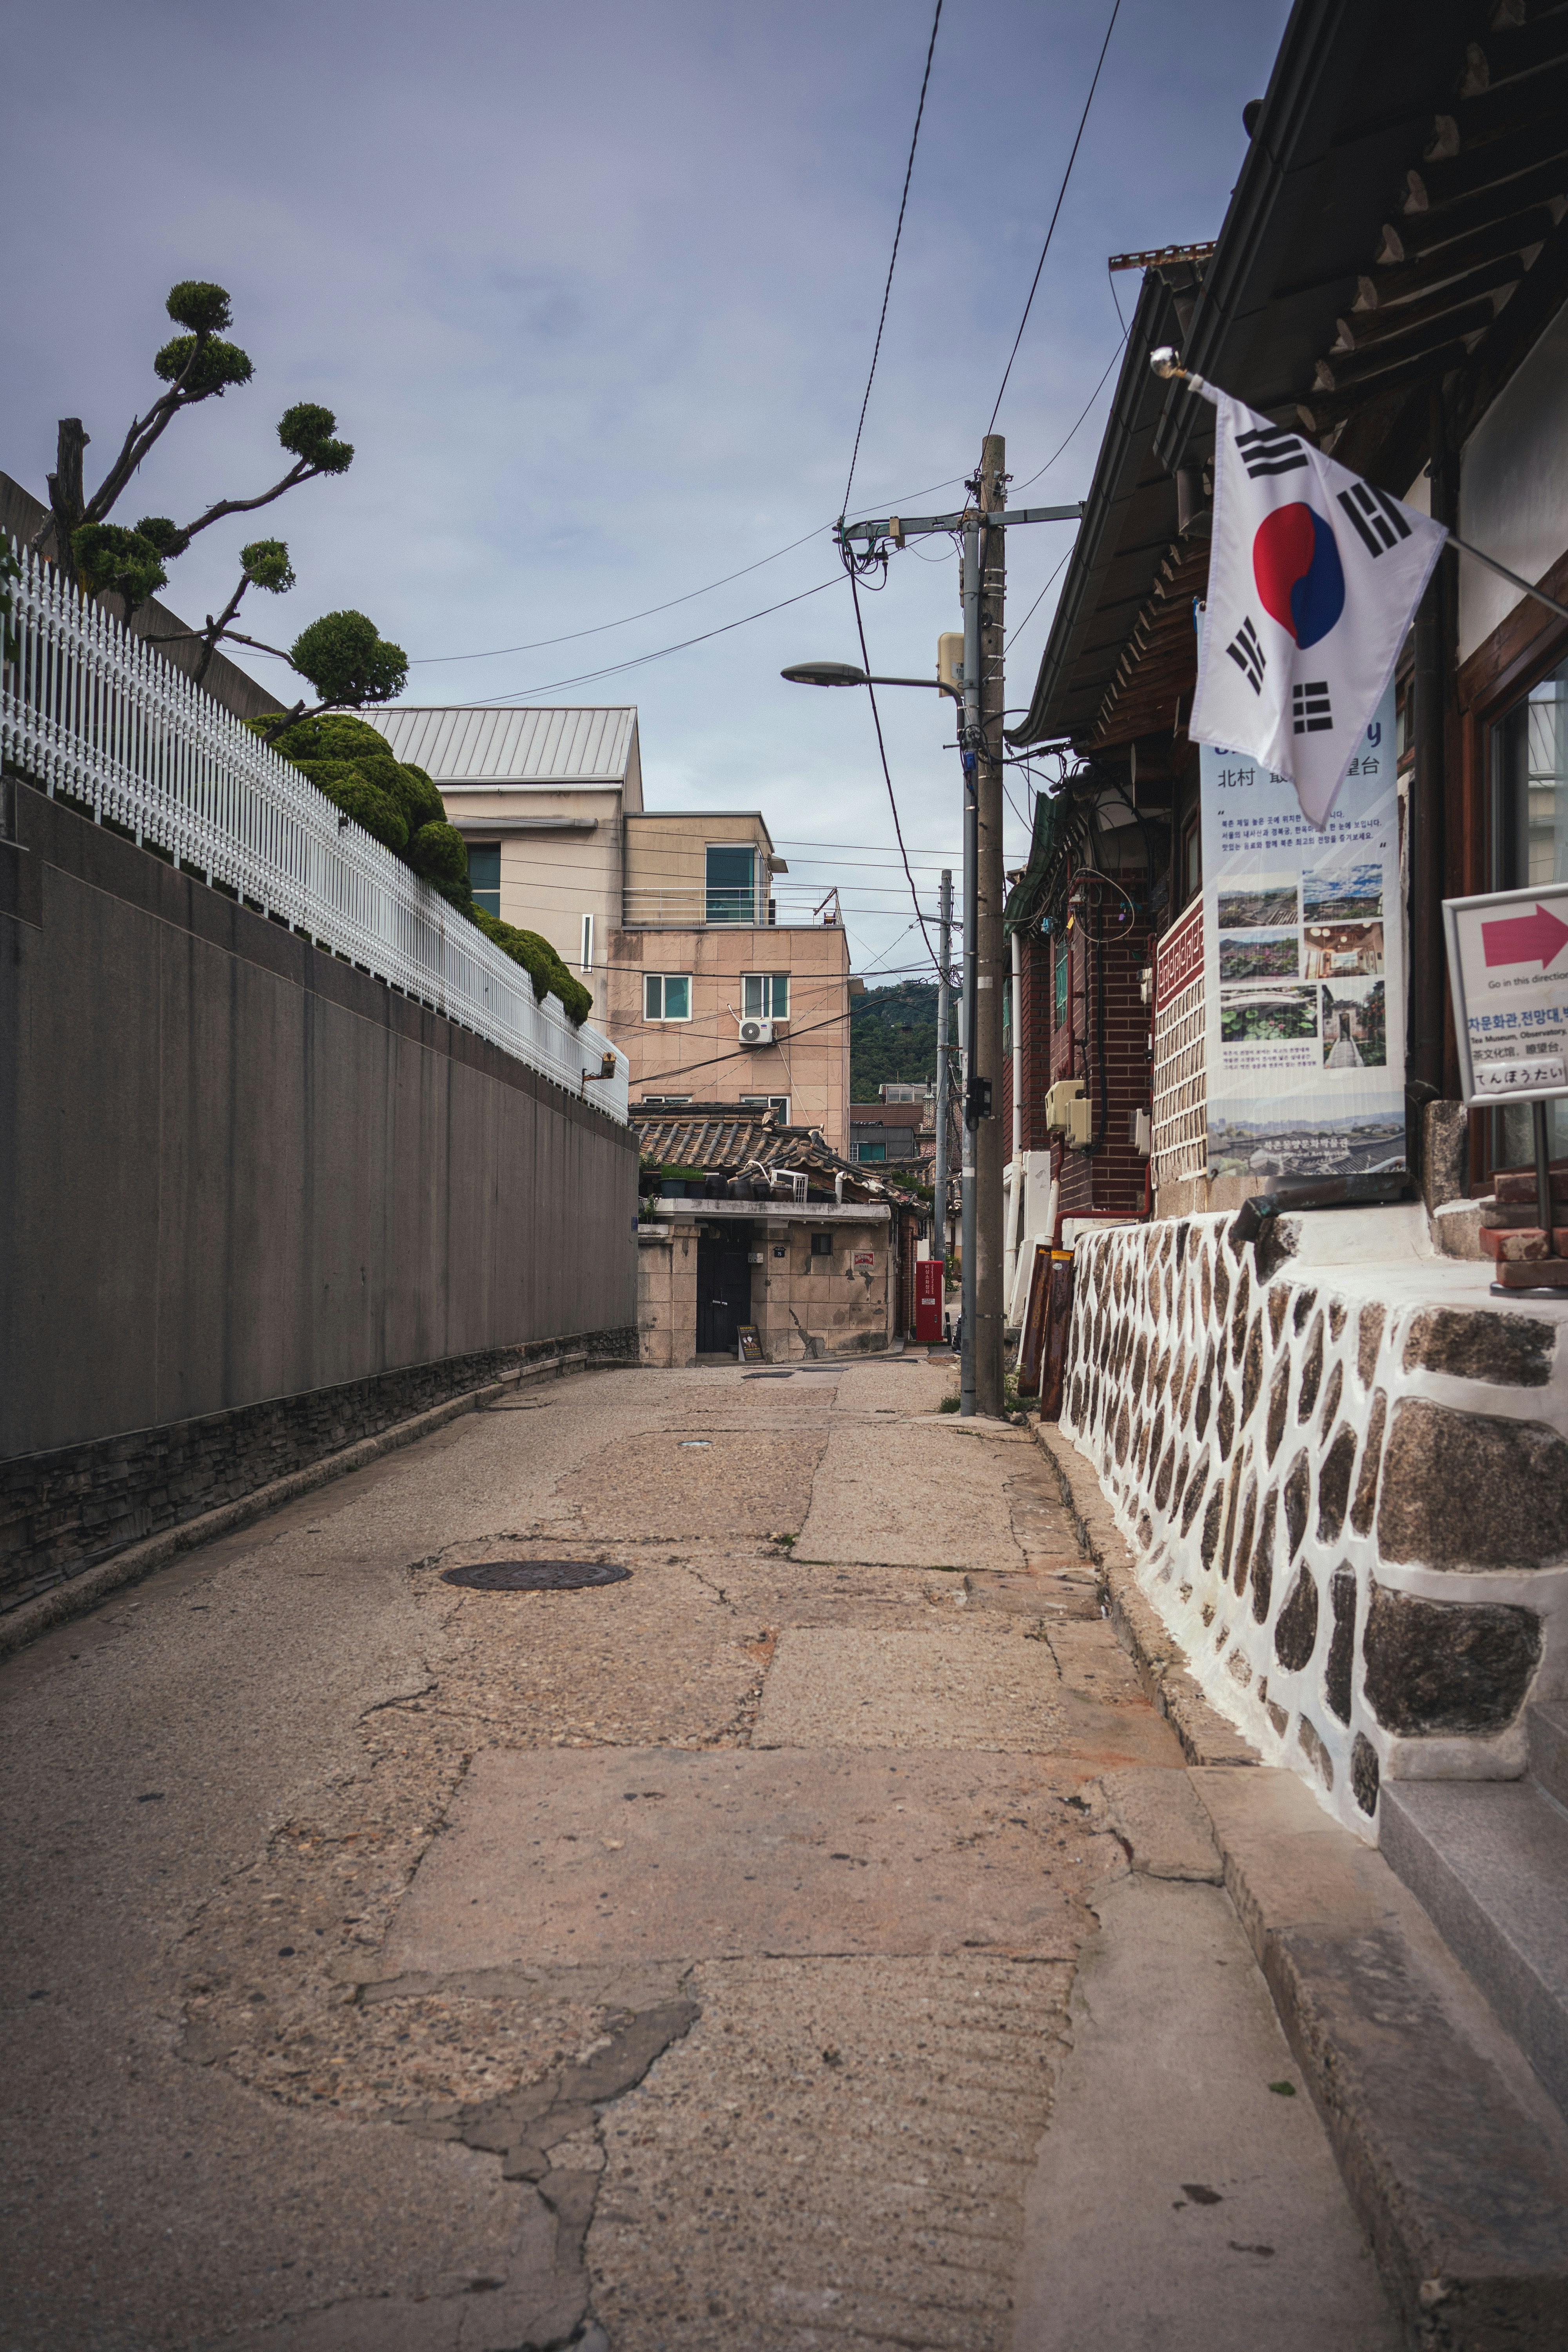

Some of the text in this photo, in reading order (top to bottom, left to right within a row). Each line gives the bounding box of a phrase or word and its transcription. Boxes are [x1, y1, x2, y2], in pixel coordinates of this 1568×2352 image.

[1218, 767, 1256, 788] 北村
[1222, 820, 1234, 828] 북촌
[1252, 817, 1264, 826] 높은
[1282, 814, 1301, 823] 위치한
[1222, 831, 1241, 840] 서울의
[1339, 822, 1351, 831] 눈에
[1354, 819, 1382, 829] 보입니다.
[1222, 843, 1241, 852] 맛있는
[1266, 840, 1278, 849] 함께
[1281, 838, 1293, 847] 북촌
[1296, 837, 1314, 846] 최고의
[1318, 835, 1336, 844] 전망을
[1488, 980, 1501, 989] Go
[1503, 978, 1512, 987] in
[1514, 976, 1530, 985] this
